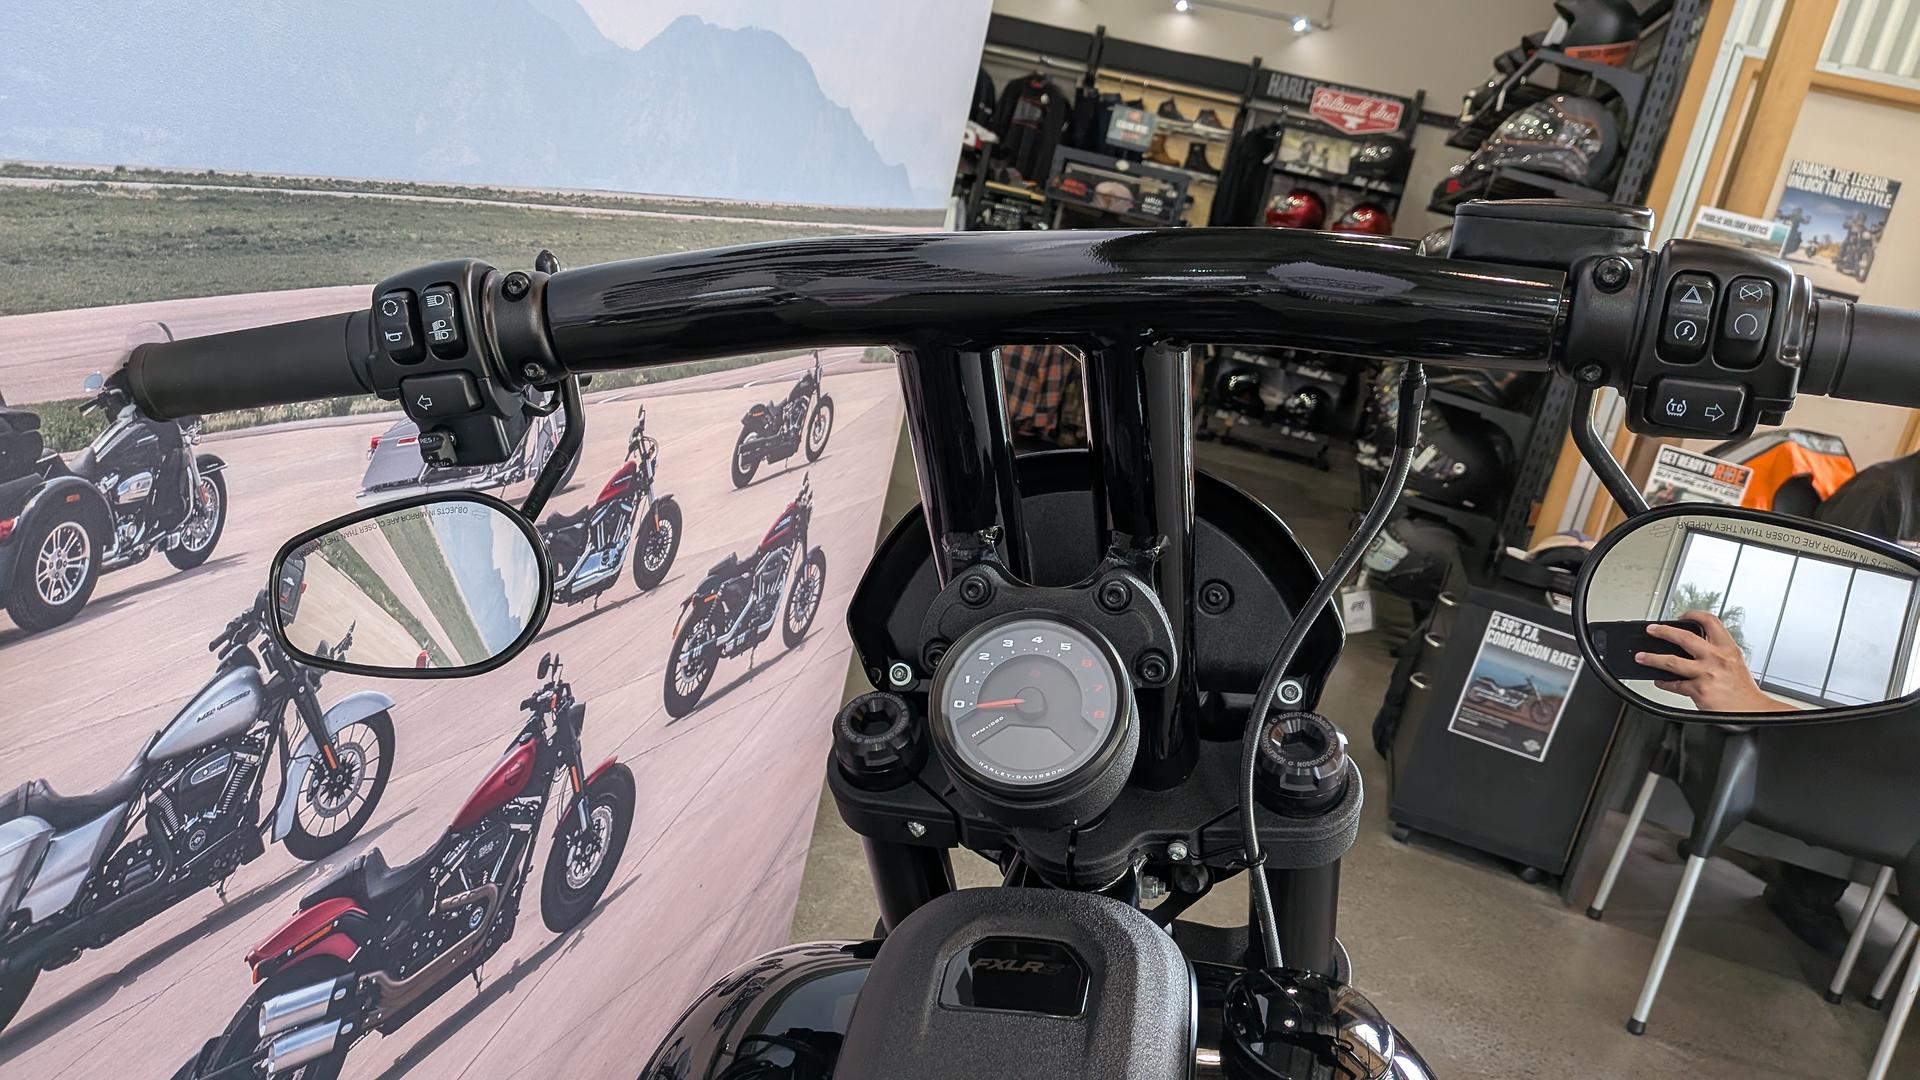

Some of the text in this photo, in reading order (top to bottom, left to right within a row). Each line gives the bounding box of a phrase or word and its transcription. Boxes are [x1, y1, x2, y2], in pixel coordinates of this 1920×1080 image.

[1791, 160, 1832, 180] FINANCE
[1832, 168, 1851, 184] THE
[1787, 174, 1826, 194] UNLOCK
[1825, 181, 1844, 198] THE
[1747, 223, 1769, 235] NOTICE
[1671, 403, 1683, 412] TC
[399, 511, 428, 523] MIRROR
[427, 509, 436, 517] IN
[436, 506, 469, 516] OBJECTS
[358, 520, 386, 534] CLOSER
[386, 516, 400, 526] ARE
[1676, 519, 1713, 531] APPEAR
[341, 528, 359, 540] THAN
[1714, 522, 1738, 534] THEY
[1738, 525, 1763, 538] THAN
[1765, 530, 1802, 546] CLOSER
[1801, 536, 1822, 550] ARE
[1822, 542, 1859, 559] MIRROR
[1858, 553, 1870, 565] IN
[1002, 639, 1014, 648] 3
[1031, 636, 1044, 644] 4
[1486, 629, 1552, 662] COMPARISON
[1060, 642, 1072, 651] 5
[978, 652, 991, 661] 2
[965, 675, 971, 683] 1
[1092, 683, 1104, 692] 7
[953, 700, 966, 708] 0
